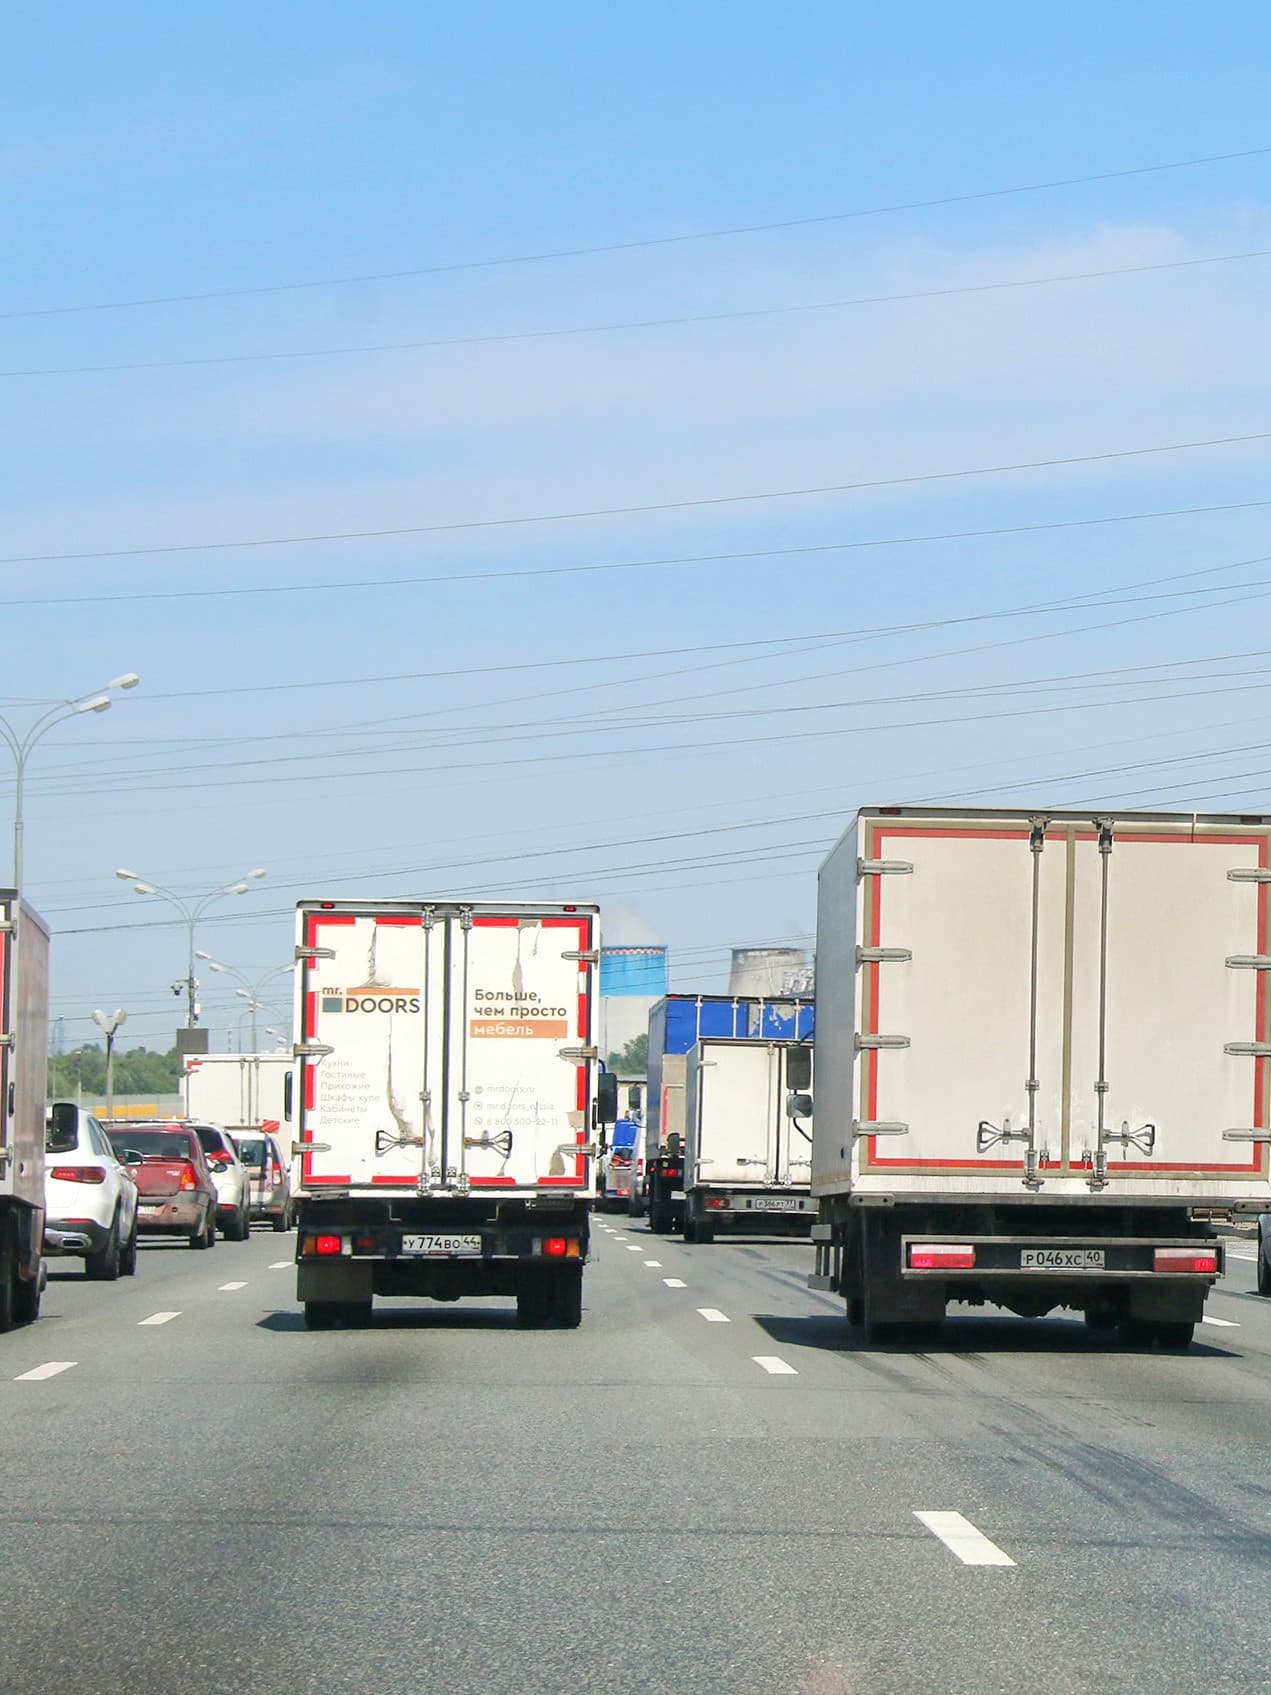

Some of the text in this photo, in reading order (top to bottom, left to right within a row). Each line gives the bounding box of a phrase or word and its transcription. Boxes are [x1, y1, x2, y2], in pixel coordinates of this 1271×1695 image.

[322, 986, 343, 995] mr.
[475, 989, 541, 1004] Больше,
[345, 998, 420, 1013] DOORS
[474, 1006, 567, 1018] чем просто
[474, 1021, 533, 1035] мебель
